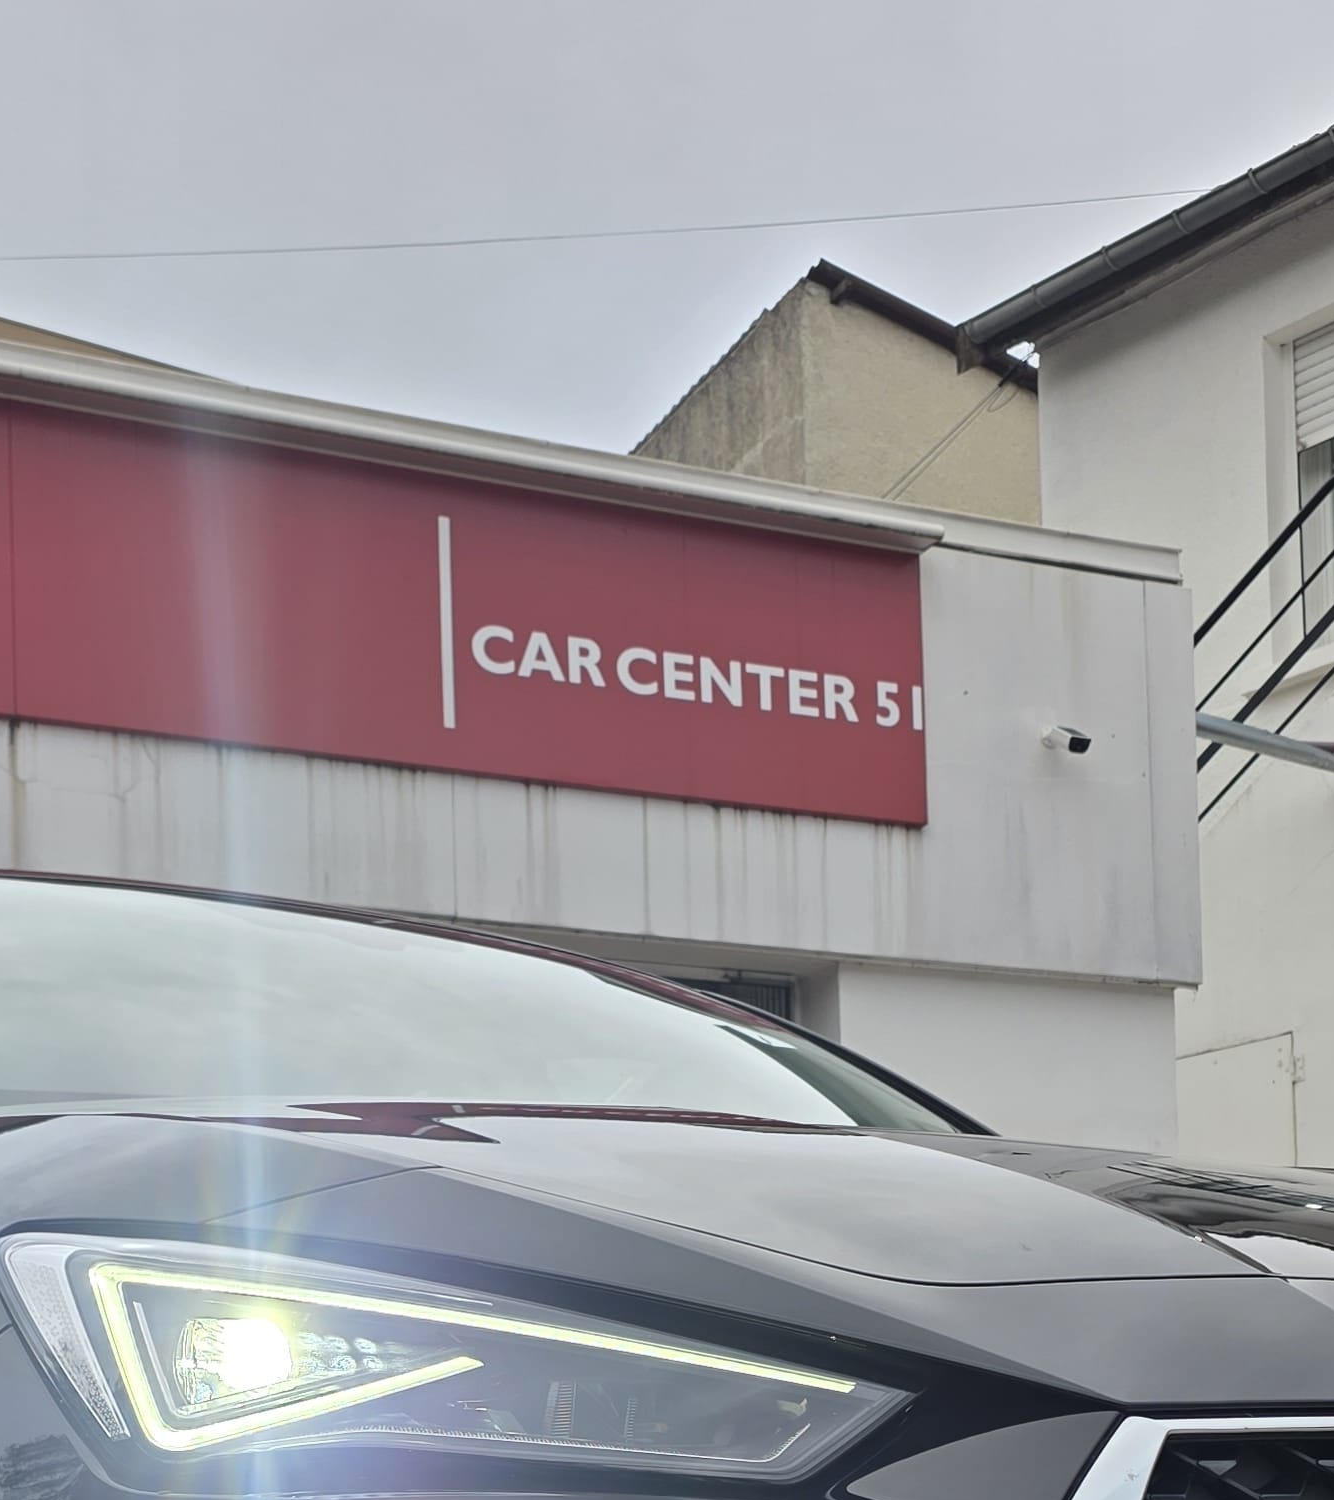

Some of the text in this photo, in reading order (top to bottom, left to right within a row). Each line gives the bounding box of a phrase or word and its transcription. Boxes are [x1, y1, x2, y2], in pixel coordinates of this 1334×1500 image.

[470, 624, 924, 731] CAR CENTER 51
